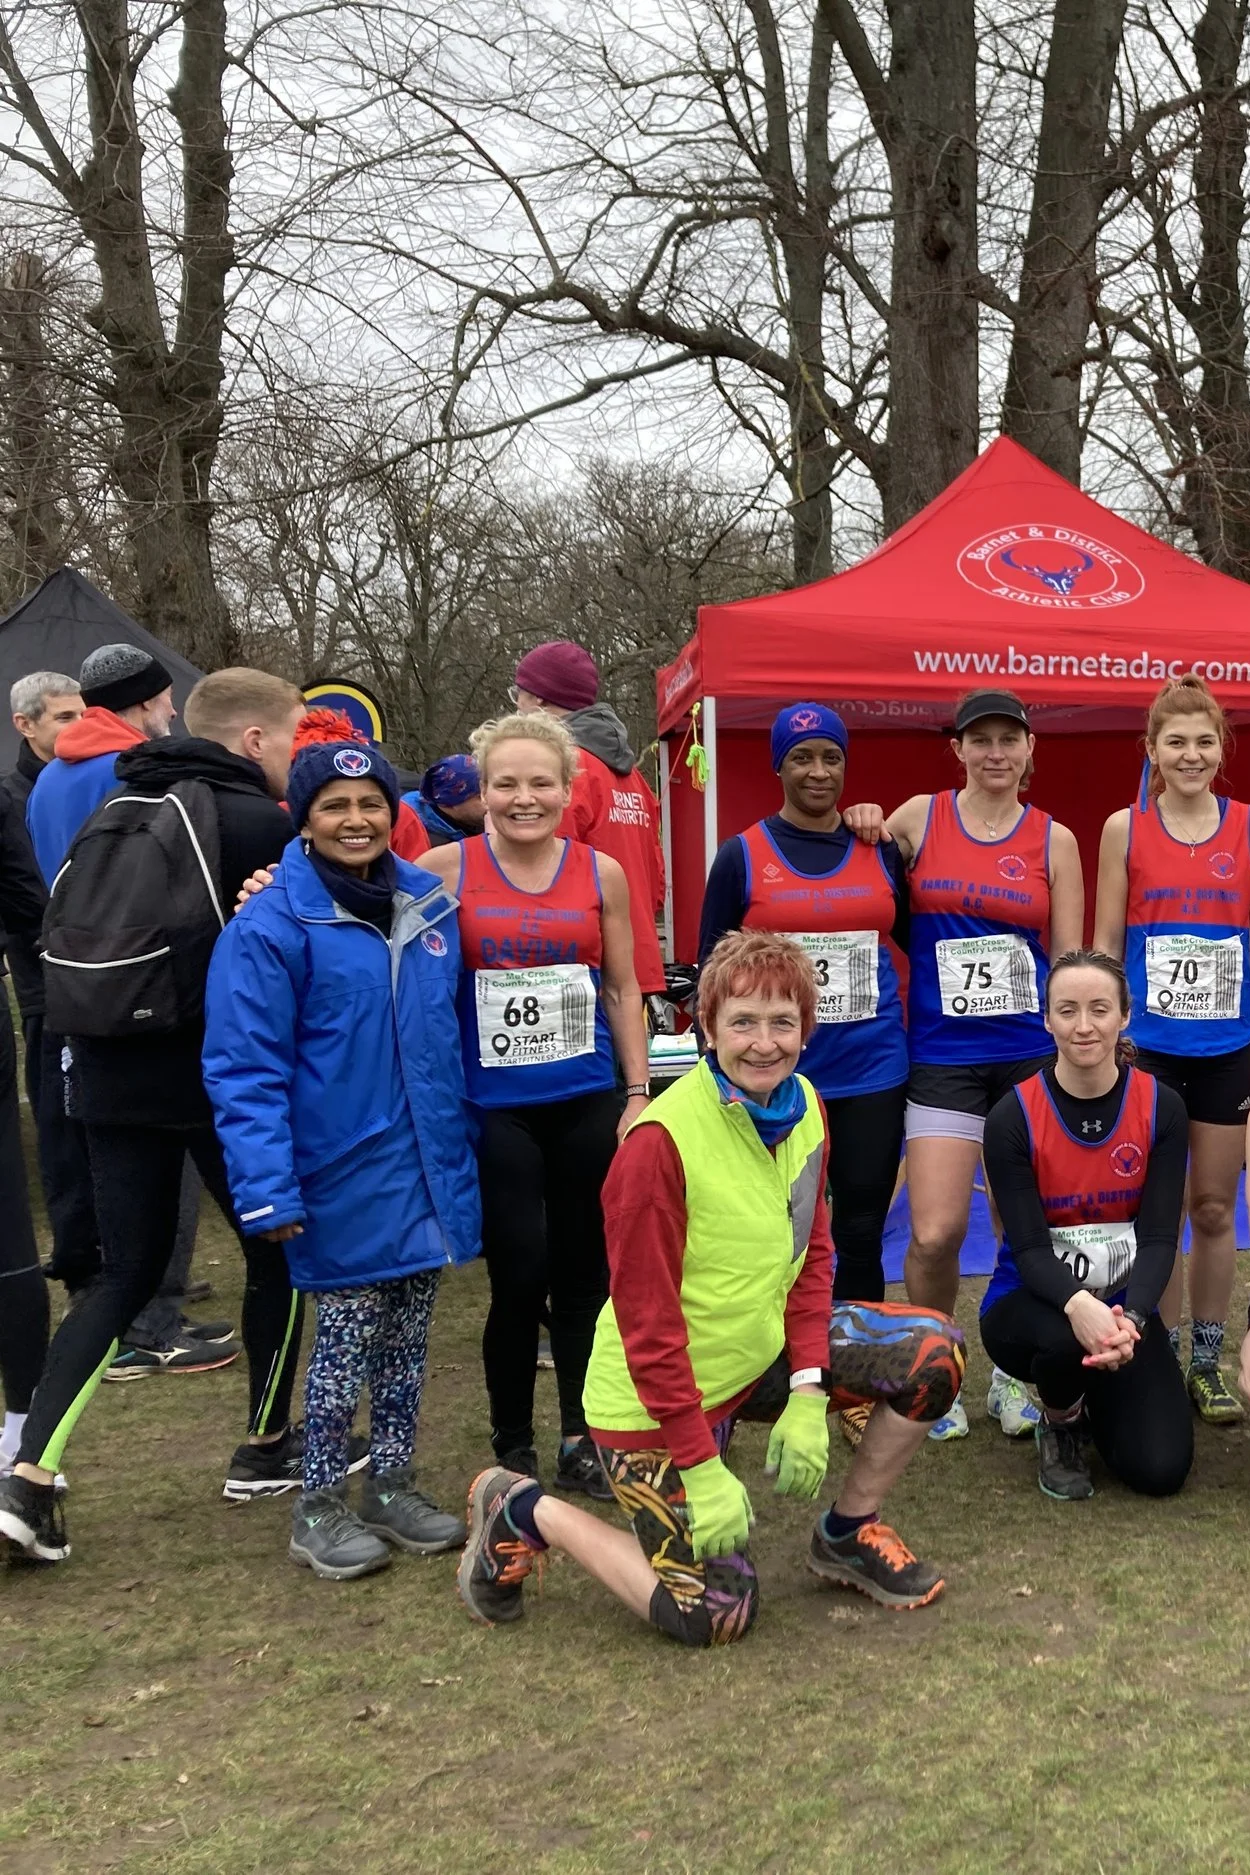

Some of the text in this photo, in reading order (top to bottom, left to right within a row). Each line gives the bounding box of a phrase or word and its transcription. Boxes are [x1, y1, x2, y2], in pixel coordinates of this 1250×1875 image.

[966, 526, 1122, 565] Barnet & District
[992, 586, 1131, 608] Athletic Club
[802, 935, 820, 943] Met
[962, 940, 979, 948] Met
[480, 936, 579, 964] DAVINA
[827, 942, 857, 950] League
[950, 947, 985, 956] Country
[987, 945, 1017, 954] League
[506, 970, 556, 981] Met Cross
[815, 958, 830, 987] 3
[961, 961, 993, 991] 75
[1168, 958, 1198, 985] 70
[492, 980, 533, 988] Country
[817, 994, 845, 1005] ART
[970, 994, 1009, 1008] START
[1174, 992, 1212, 1002] START
[503, 995, 541, 1028] 68
[817, 1004, 843, 1013] NESS
[1173, 1002, 1210, 1010] FITNESS
[513, 1031, 558, 1047] START
[512, 1043, 557, 1056] FITNESS
[1057, 1228, 1102, 1238] Met Cross
[1084, 1235, 1113, 1244] League
